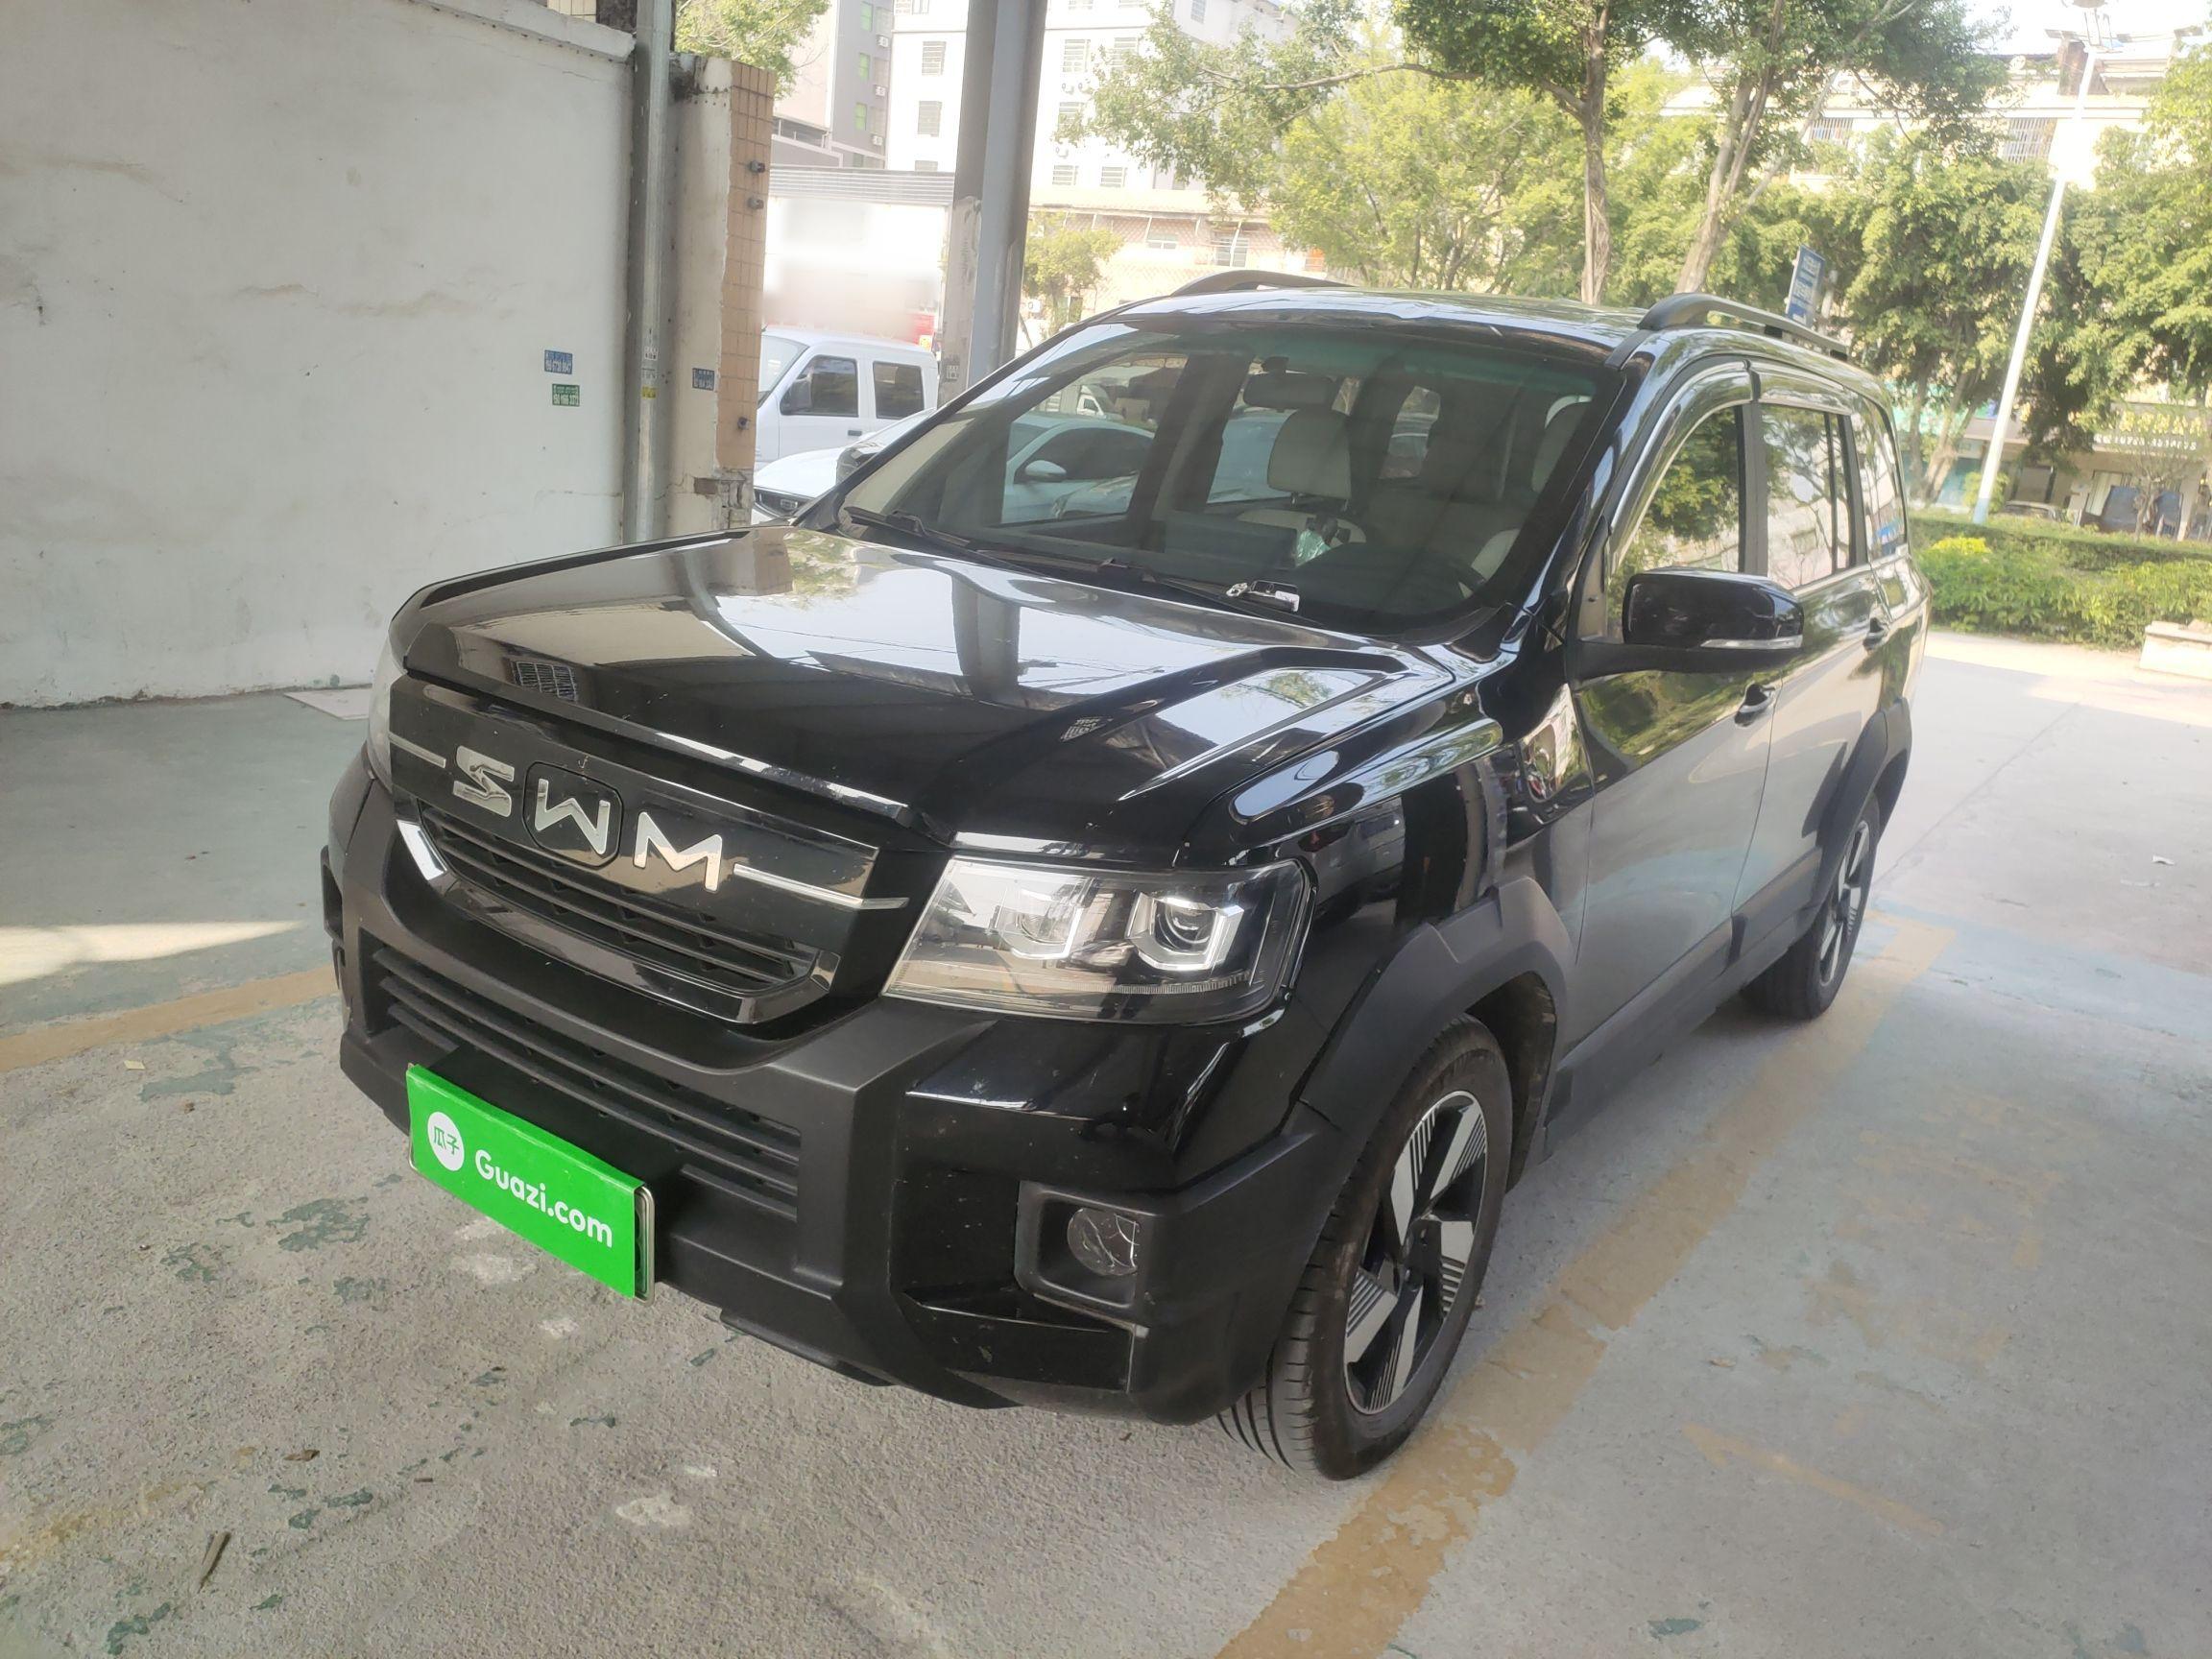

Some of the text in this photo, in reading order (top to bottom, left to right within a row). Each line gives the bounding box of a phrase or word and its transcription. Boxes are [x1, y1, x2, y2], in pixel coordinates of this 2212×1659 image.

[452, 745, 723, 892] SWM
[434, 1125, 460, 1155] 瓜子
[474, 1149, 613, 1248] Guazi.com
